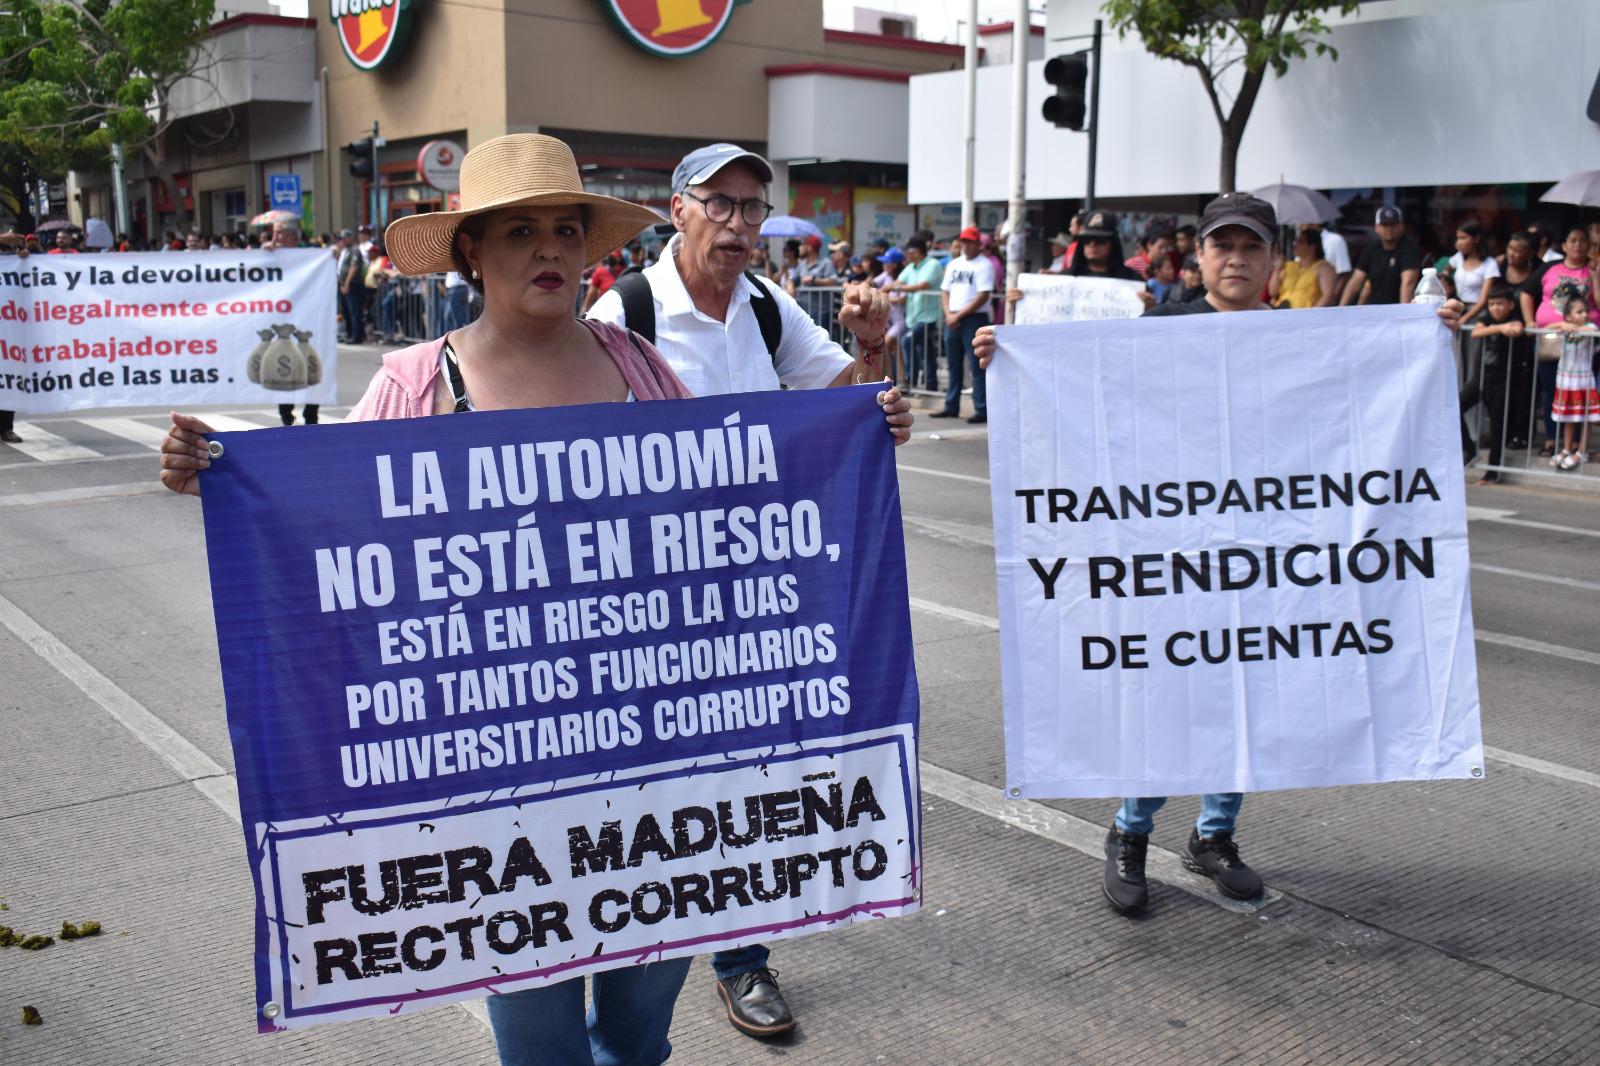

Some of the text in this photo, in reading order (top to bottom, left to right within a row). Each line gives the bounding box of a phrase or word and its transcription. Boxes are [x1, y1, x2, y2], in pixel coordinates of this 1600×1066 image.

[0, 263, 283, 291] ncia y la devolucion
[0, 299, 293, 325] do ilegalmente como
[0, 336, 218, 364] los trabajadores
[79, 366, 114, 388] de
[122, 365, 162, 386] las
[170, 367, 219, 384] uas
[376, 411, 778, 518] LA AUTONOMÍA
[1016, 468, 1440, 523] TRANSPARENCIA
[315, 499, 841, 612] NO ESTÁ EN RIESGO,
[1028, 528, 1435, 599] Y RENDICIÓN
[378, 573, 800, 665] ESTÁ EN RIESGO LA UAS
[1081, 619, 1394, 670] DE CUENTAS
[345, 623, 837, 729] POR TANTOS FUNCIONARIOS
[340, 676, 851, 788] UNIVERSITARIOS CORRUPTOS
[302, 771, 887, 925] FUERA MADUEÑA
[314, 839, 888, 985] RECTOR CORRUPTO
